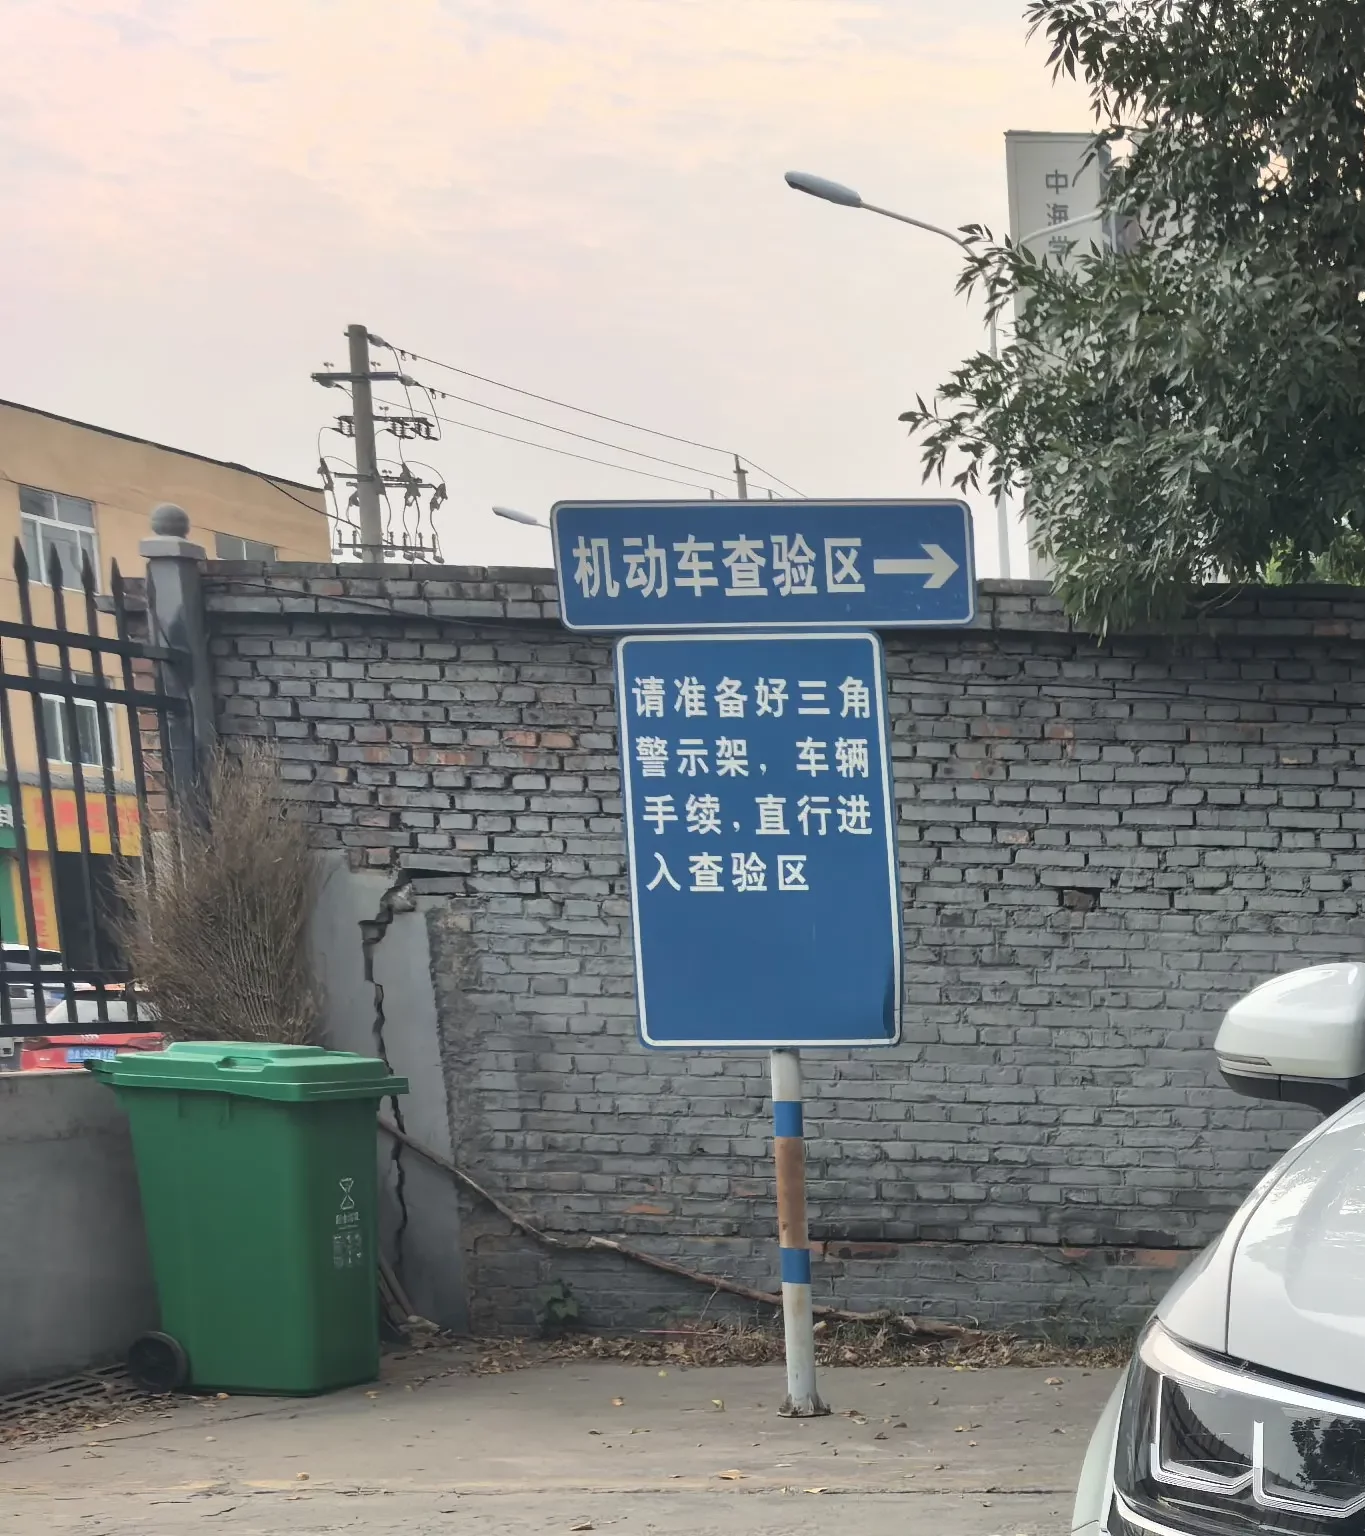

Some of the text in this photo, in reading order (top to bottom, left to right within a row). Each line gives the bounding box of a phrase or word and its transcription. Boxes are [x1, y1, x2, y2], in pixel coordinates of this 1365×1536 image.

[572, 533, 866, 598] 机动车查验区
[631, 675, 871, 719] 请准备好三角
[646, 851, 810, 893] 入查验区
